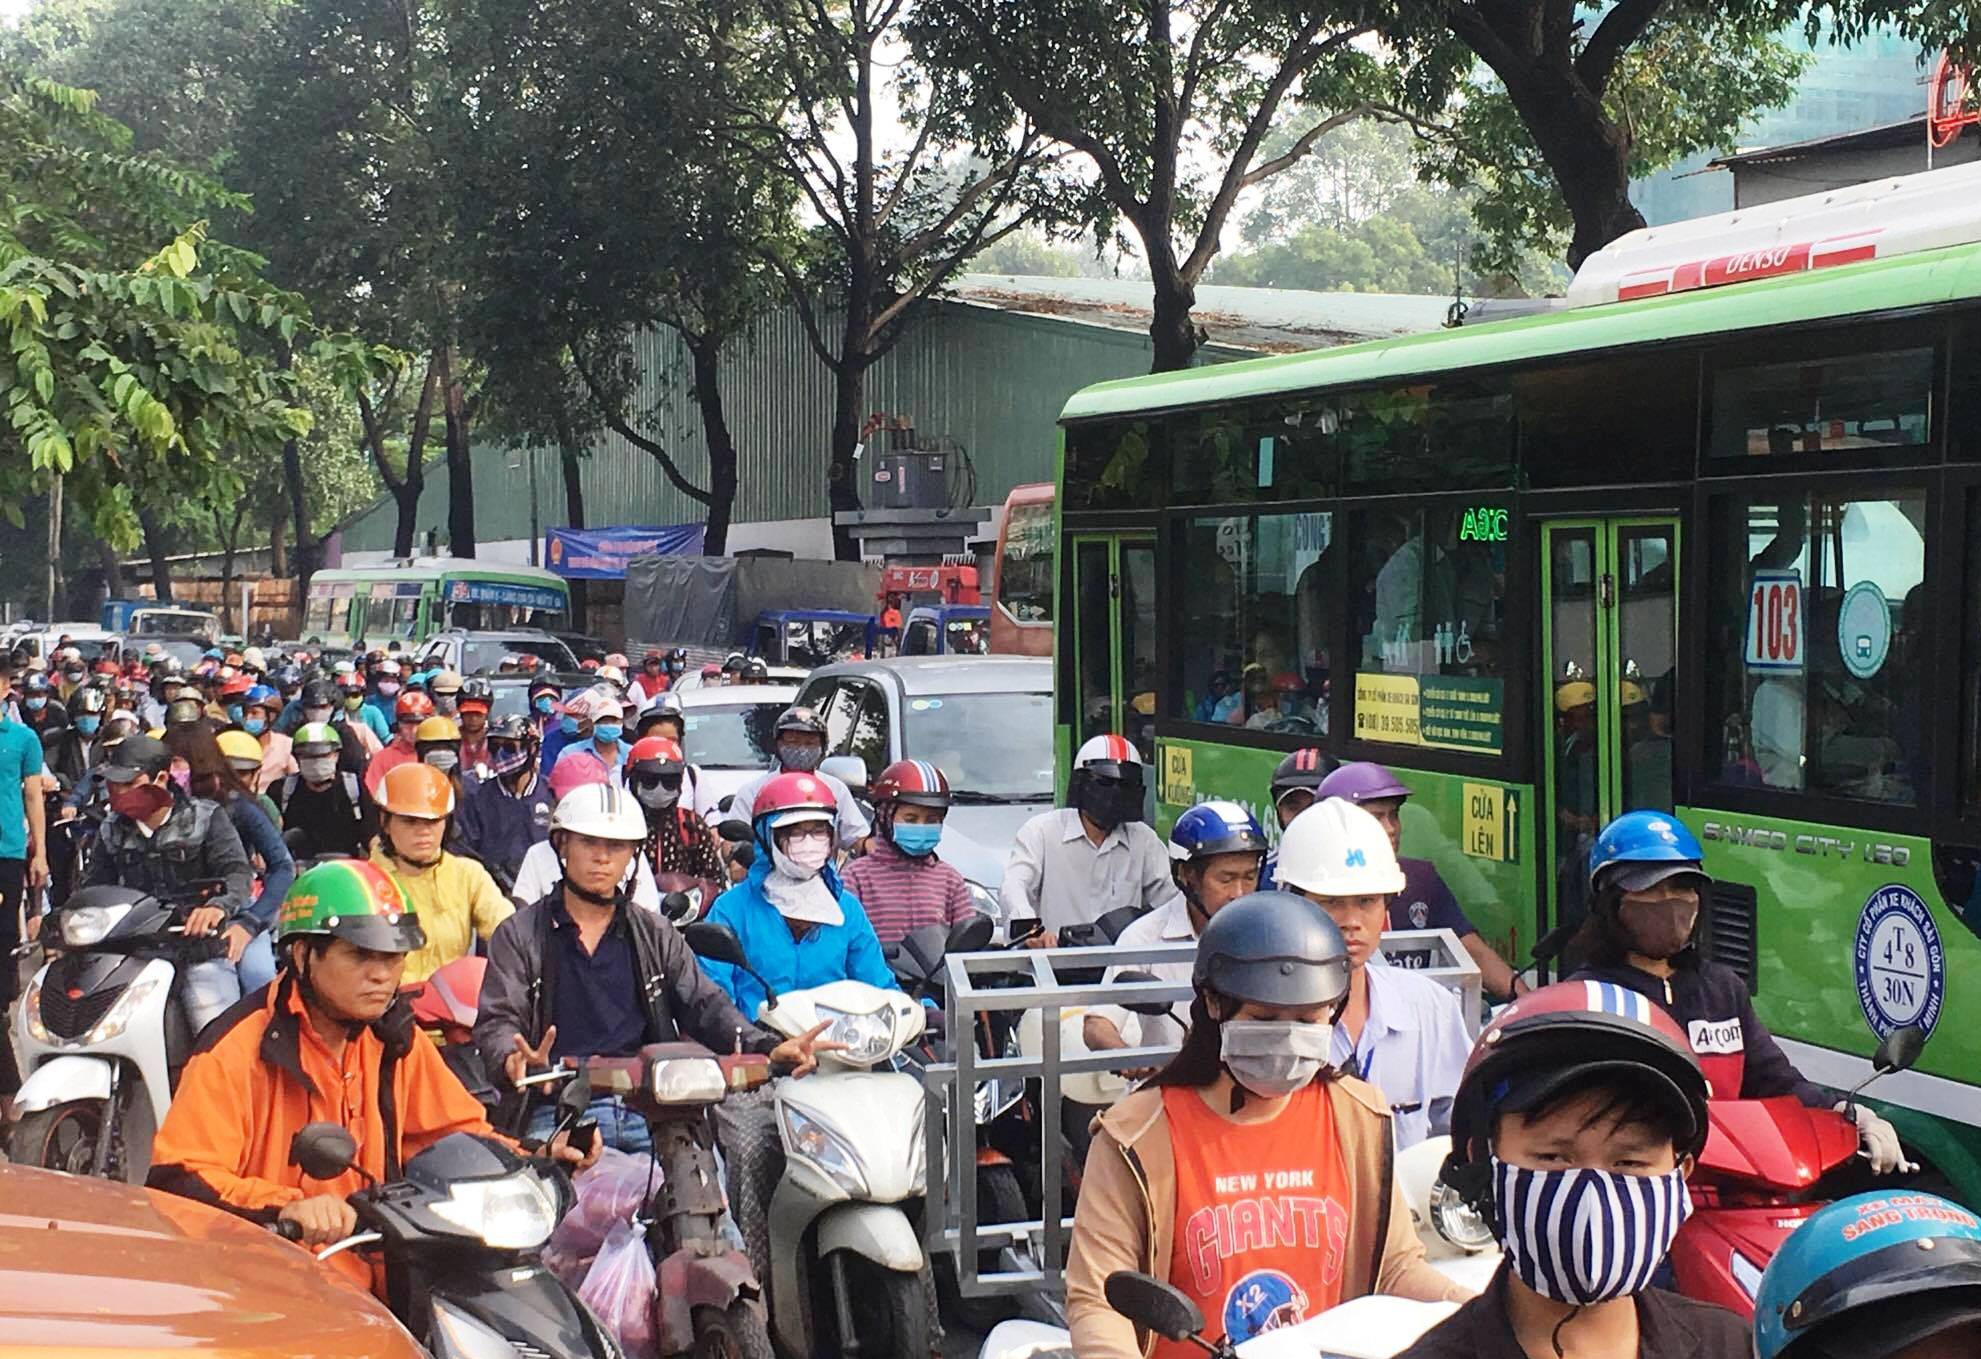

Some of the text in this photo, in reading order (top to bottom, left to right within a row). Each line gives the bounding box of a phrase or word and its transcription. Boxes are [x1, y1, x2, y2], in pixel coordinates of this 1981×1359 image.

[1725, 246, 1792, 275] DENSO
[1754, 584, 1797, 660] 103
[1471, 788, 1494, 822] CỬA
[1471, 826, 1493, 857] LÊN
[1704, 822, 1787, 850] SAMCO
[1795, 834, 1855, 860] CITY
[1888, 892, 1900, 907] XE
[1883, 976, 1915, 1008] 30N
[1215, 1169, 1315, 1193] NEW YORK
[1840, 1209, 1904, 1242] SANG
[1185, 1195, 1349, 1297] GIANTS
